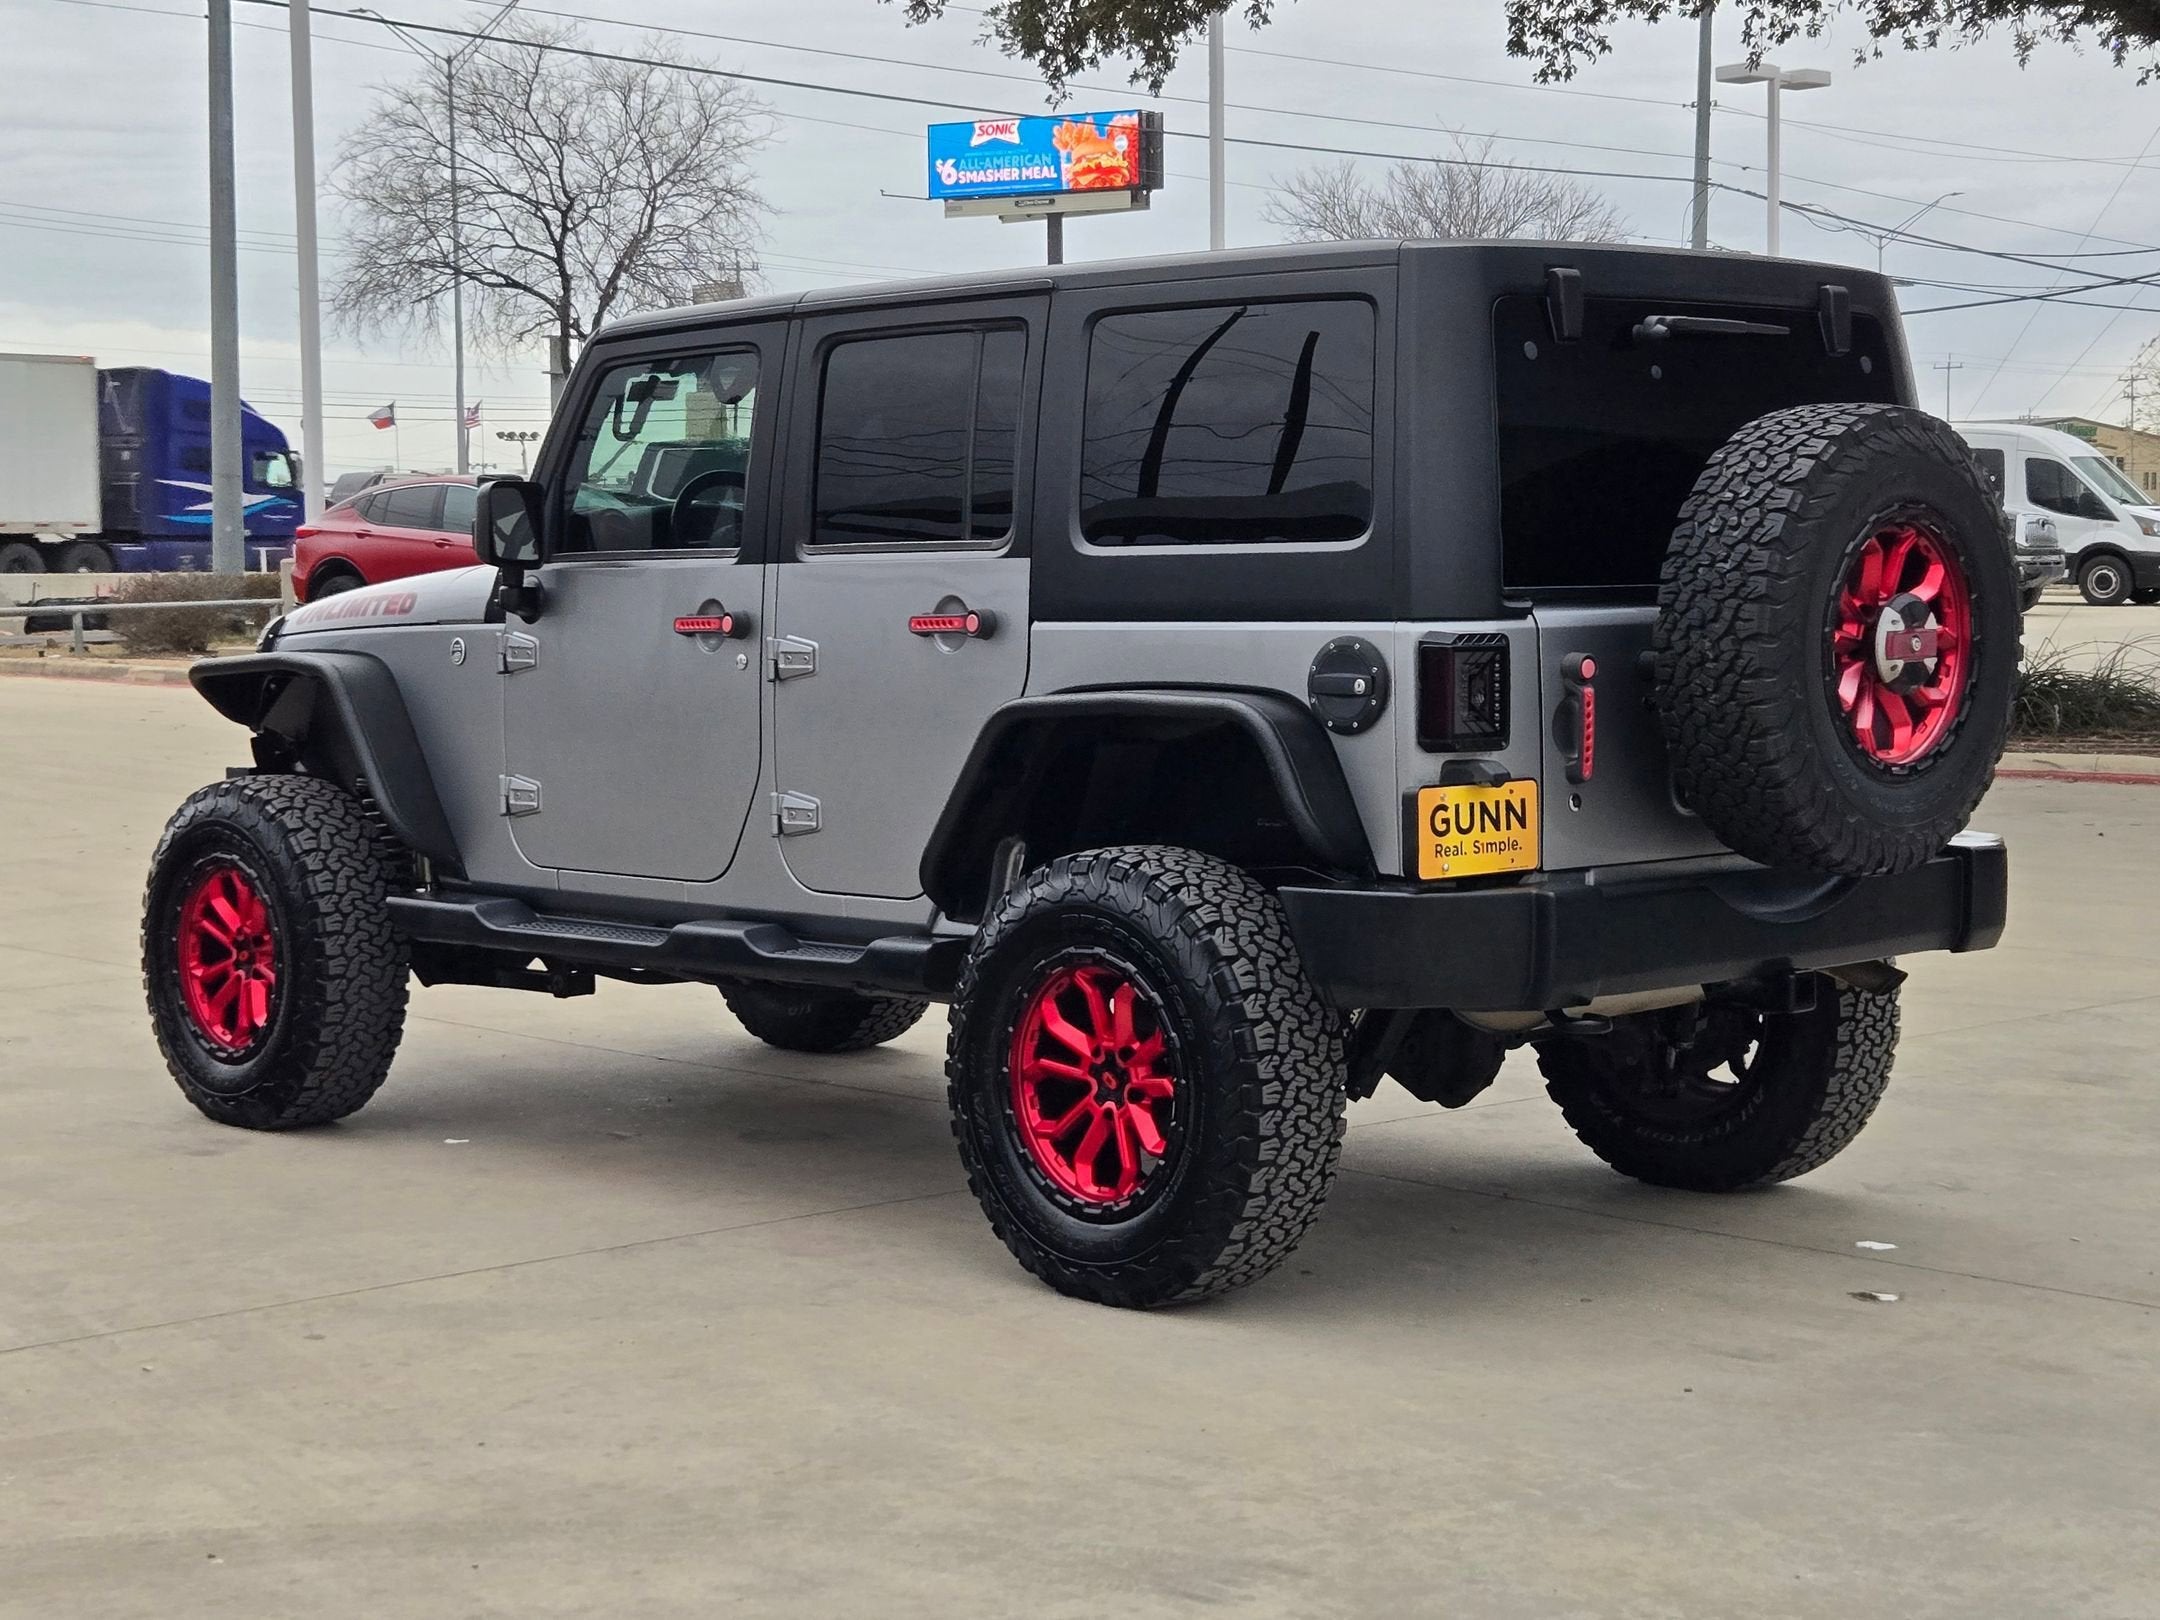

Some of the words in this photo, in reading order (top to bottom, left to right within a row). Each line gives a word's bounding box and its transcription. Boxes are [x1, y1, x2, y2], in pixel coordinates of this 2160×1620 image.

[977, 122, 1016, 137] SONIC
[958, 152, 1052, 171] ALL-AMERICAN
[935, 158, 957, 186] $6
[957, 167, 1020, 184] SMASHER
[1021, 165, 1058, 180] MEAL
[296, 592, 418, 625] UNLIMITED
[1429, 797, 1527, 838] GUNN
[1434, 841, 1467, 858] Real.
